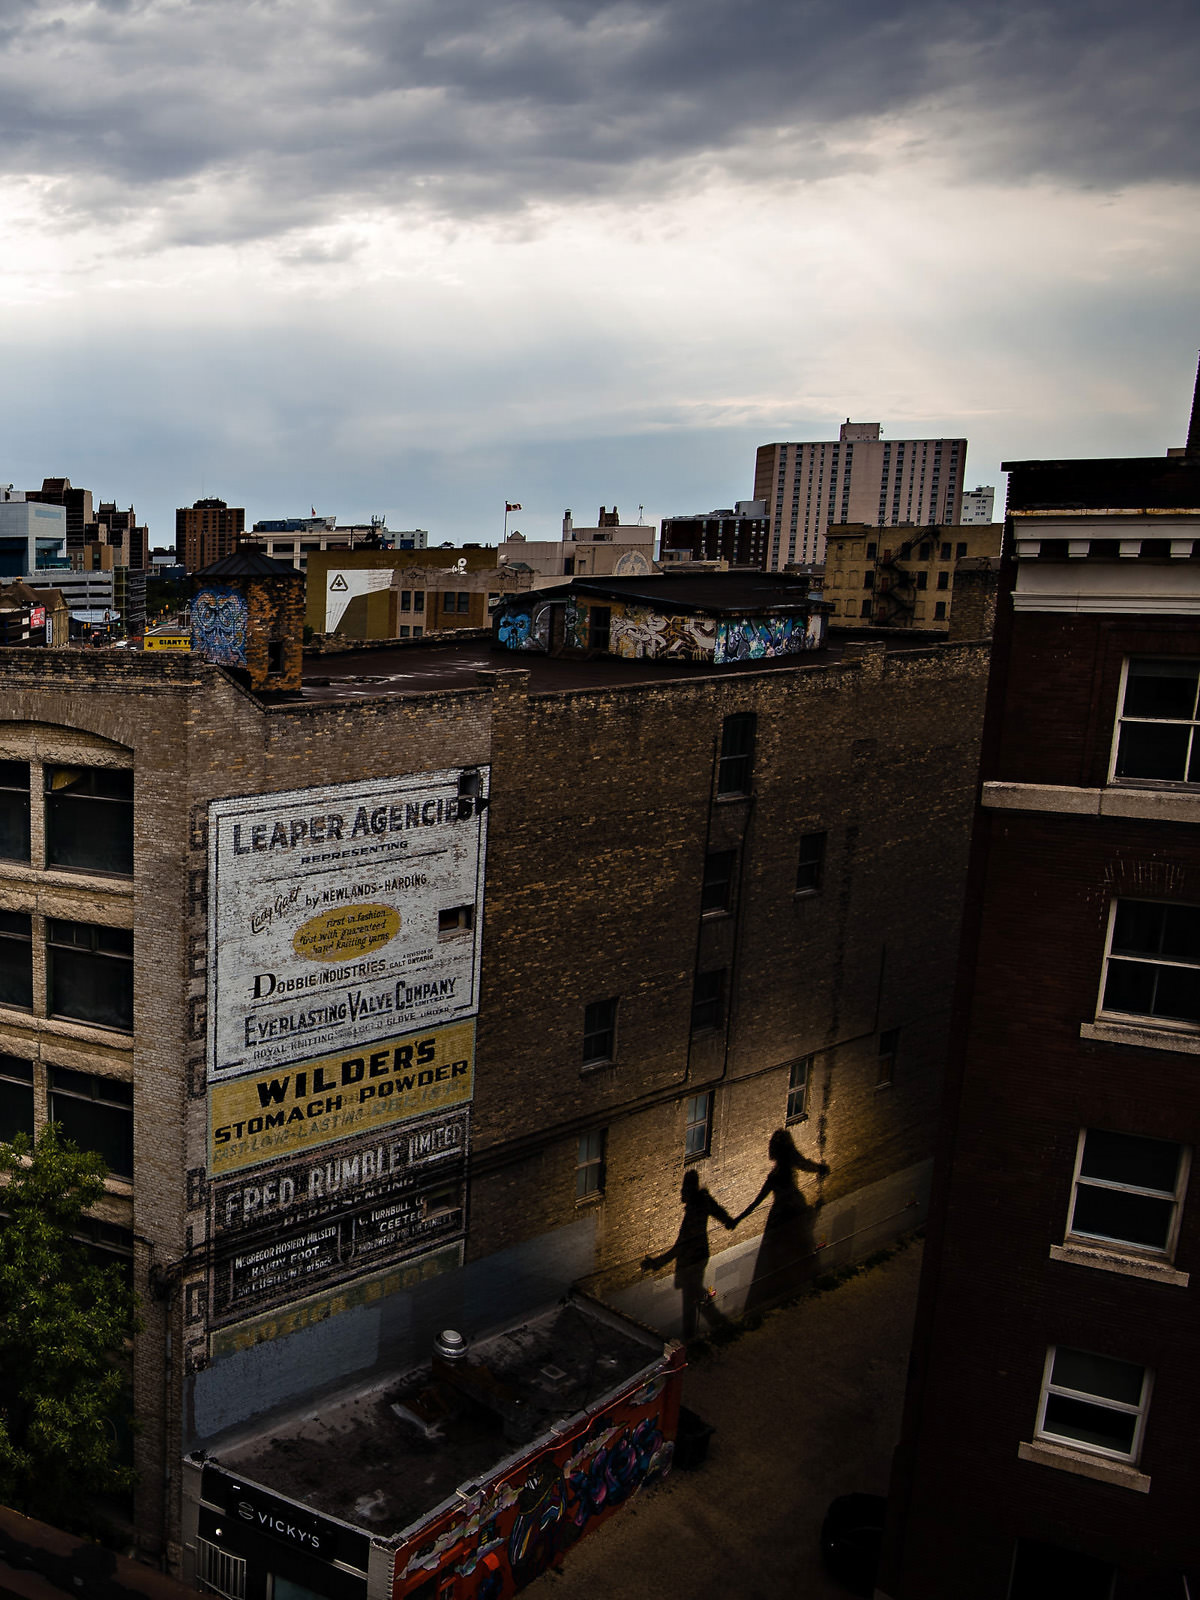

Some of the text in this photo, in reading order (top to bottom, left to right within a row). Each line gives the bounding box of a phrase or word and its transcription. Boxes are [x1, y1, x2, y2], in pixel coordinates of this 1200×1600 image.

[233, 799, 474, 856] LEAPER AGENCIES
[301, 841, 408, 864] REPRESENTING
[305, 895, 320, 910] by
[319, 930, 338, 942] with
[368, 932, 390, 946] yarns
[407, 954, 434, 965] ONTARIO
[249, 973, 318, 1000] DOBBIE
[245, 1003, 347, 1048] EVERLASTING
[348, 991, 393, 1022] VALVE
[396, 977, 457, 1011] COMPANY
[257, 1038, 436, 1108] WILDER'S
[215, 1060, 469, 1145] STOMACH POWDER
[225, 1124, 462, 1227] FRED RUMBLE LIMITED
[370, 1200, 412, 1222] TURNBULL
[379, 1211, 424, 1232] CEETEE
[275, 1236, 306, 1256] HOSIERY
[290, 1246, 320, 1264] FOOT
[258, 1510, 321, 1549] VICKY'S
